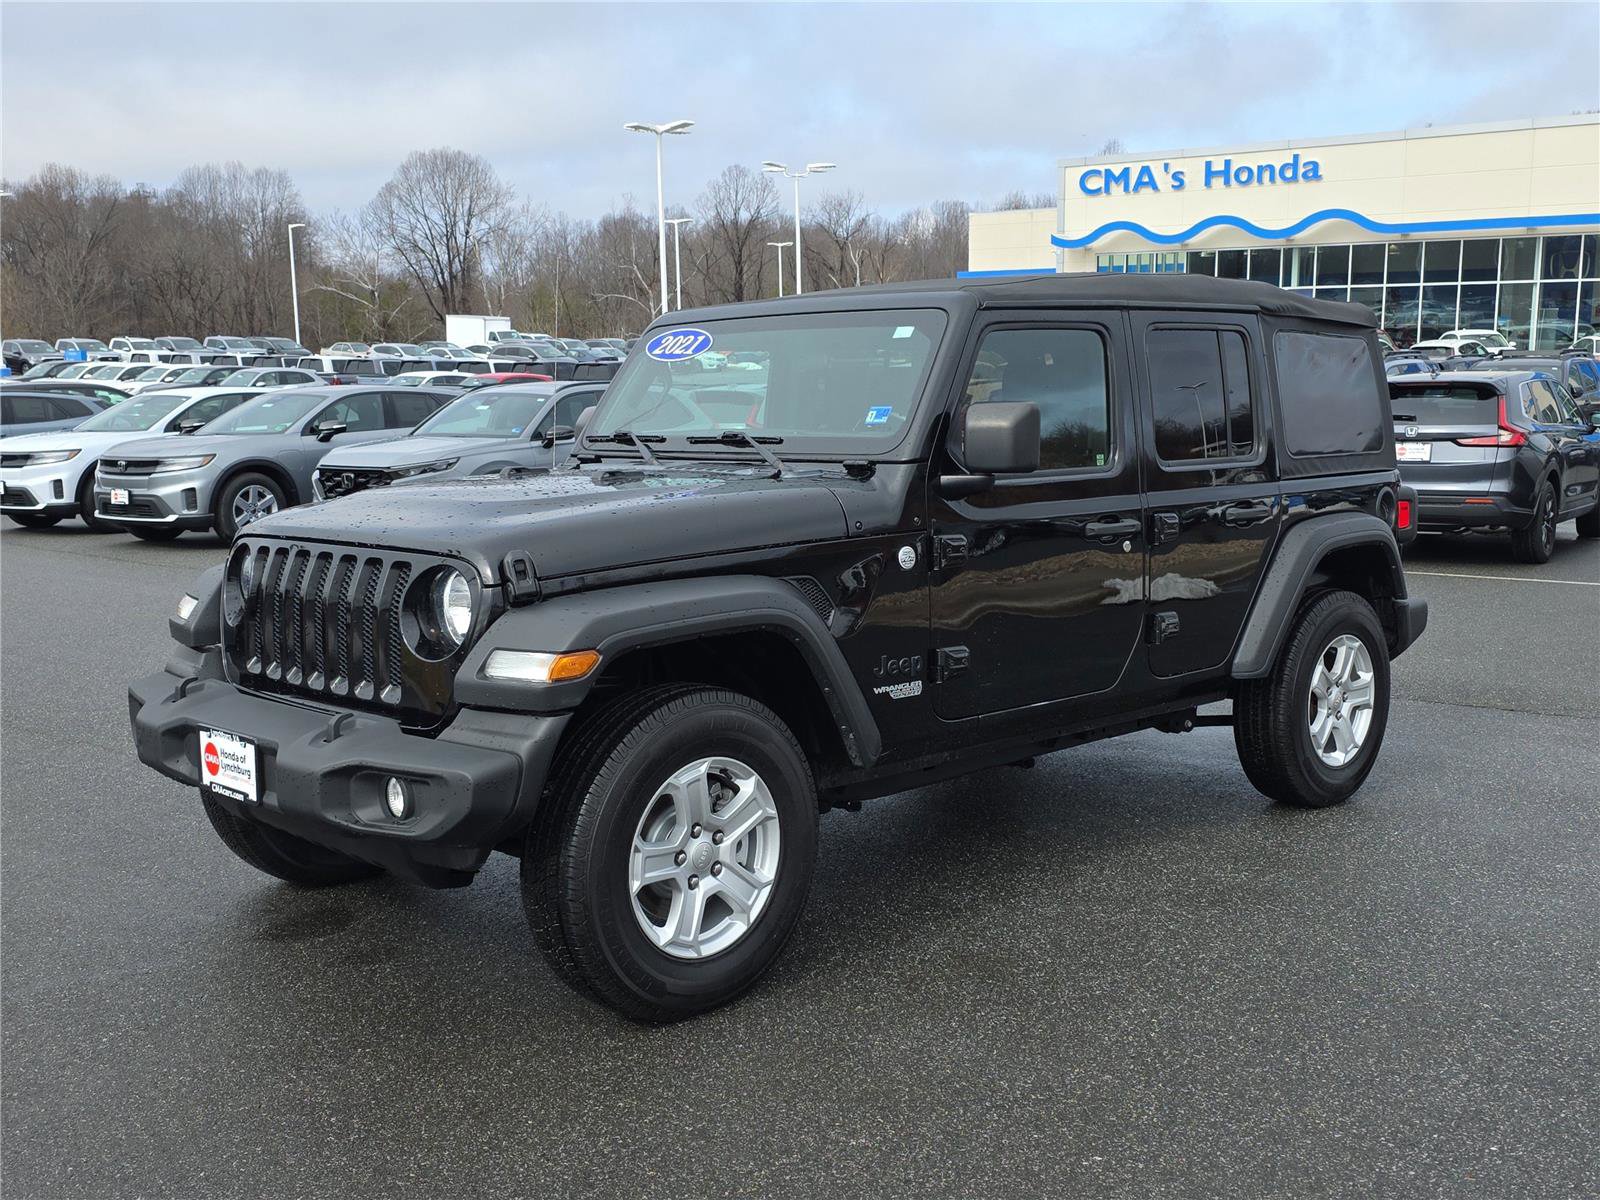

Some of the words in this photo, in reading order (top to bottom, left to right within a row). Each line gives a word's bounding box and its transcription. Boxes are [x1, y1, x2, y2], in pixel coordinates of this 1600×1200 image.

[1079, 162, 1186, 196] CMA's
[1204, 153, 1323, 189] Honda
[651, 335, 706, 355] 2021
[873, 654, 921, 679] Jeep
[873, 680, 922, 695] WRANGLER
[220, 748, 239, 762] Honda
[239, 755, 247, 764] of
[220, 760, 252, 780] Lynchburg
